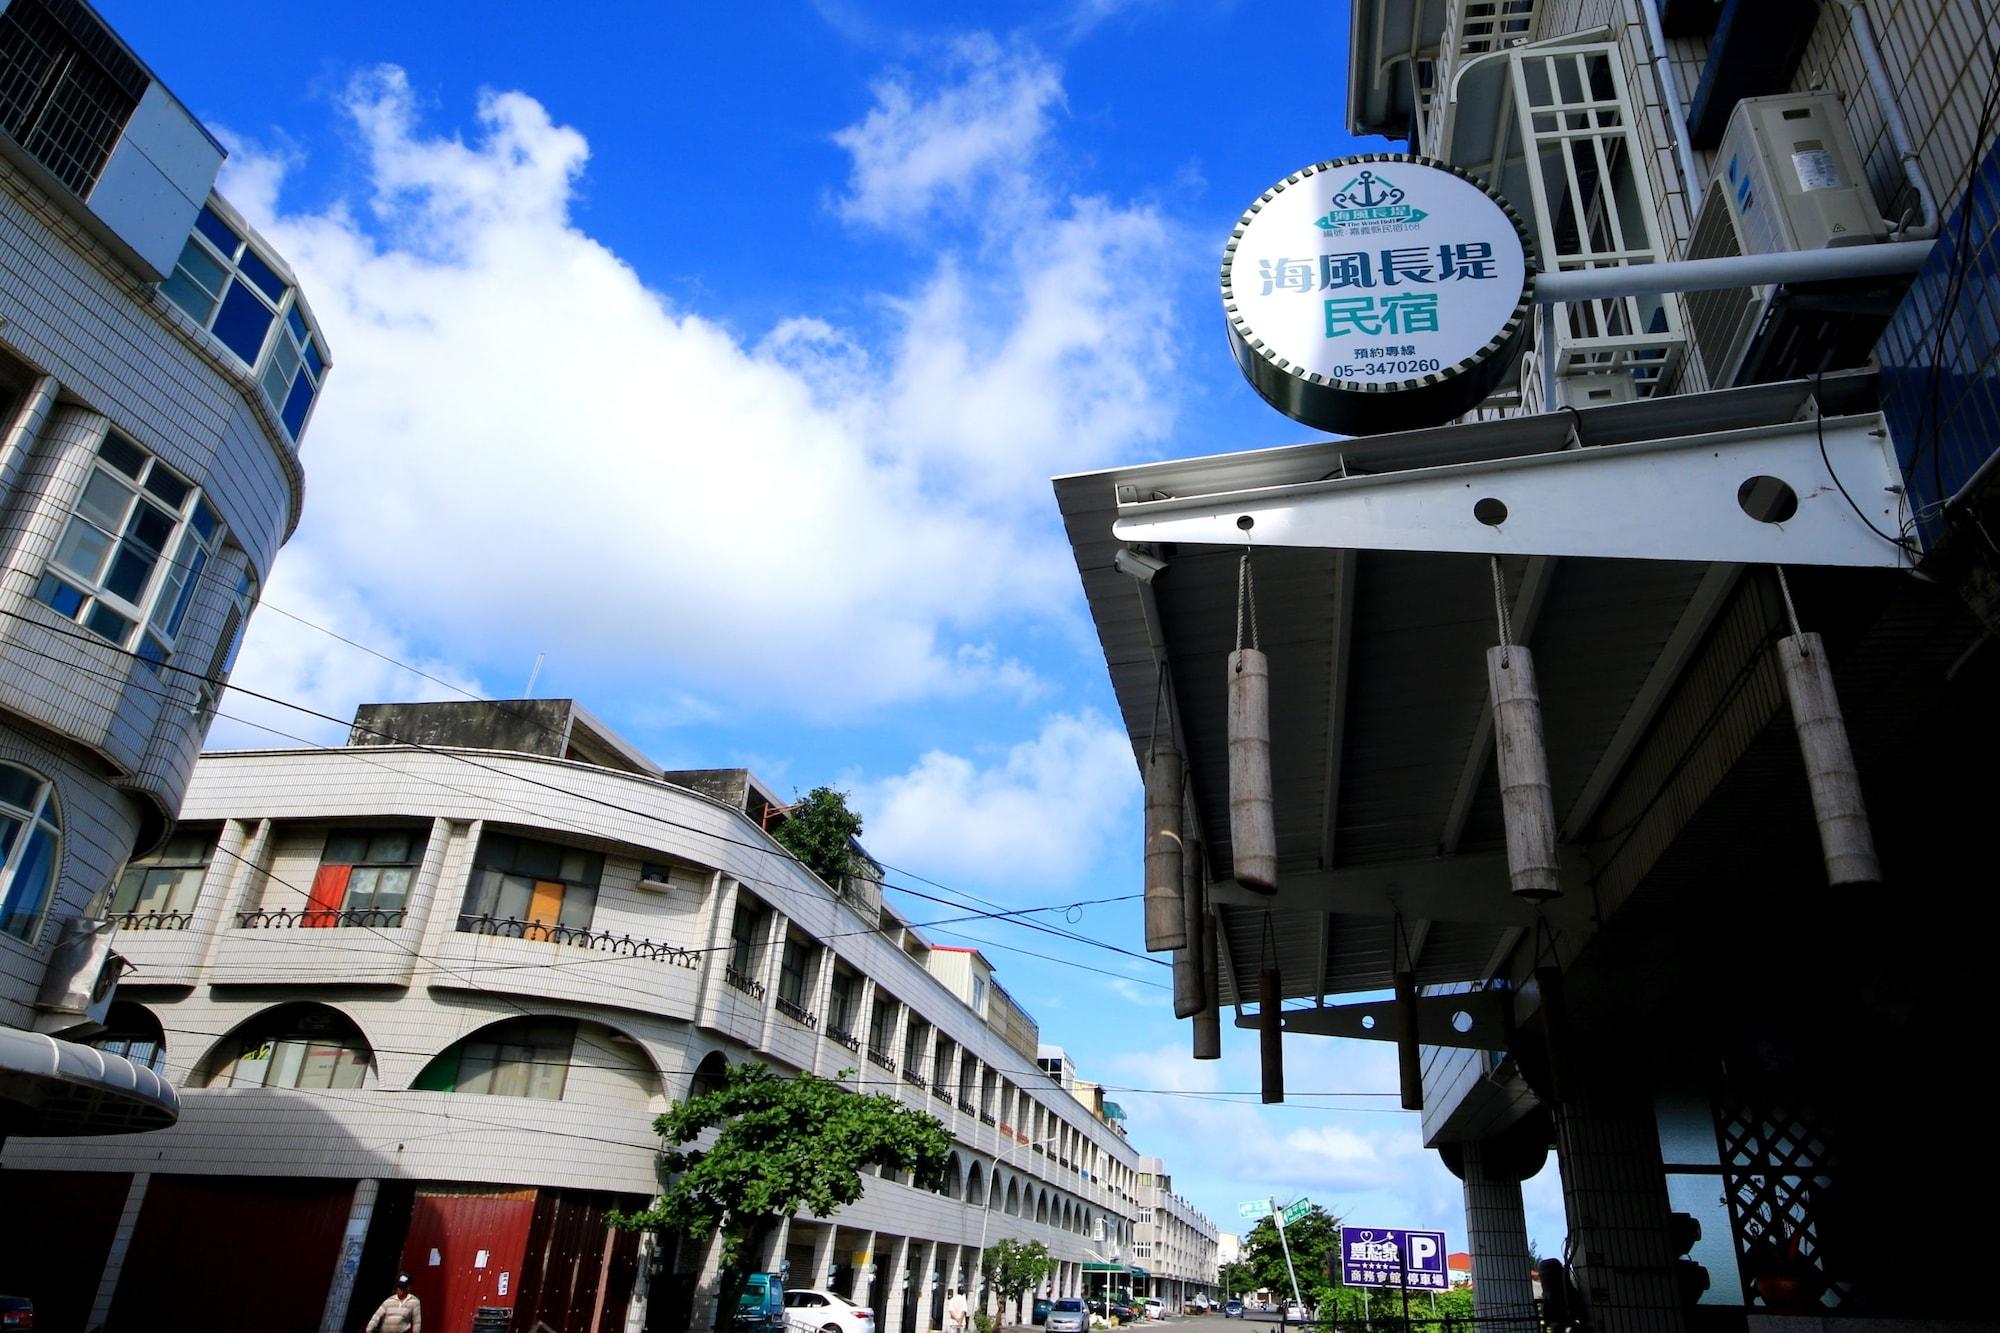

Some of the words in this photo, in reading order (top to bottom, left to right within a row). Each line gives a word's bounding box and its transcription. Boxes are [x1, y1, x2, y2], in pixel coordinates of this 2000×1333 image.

[1259, 242, 1498, 296] 海風長堤
[1324, 293, 1439, 338] 民宿
[1353, 346, 1416, 360] 預約專線
[1333, 359, 1440, 378] 05-3470260
[1411, 1237, 1437, 1269] P
[1407, 1272, 1444, 1287] 停車場
